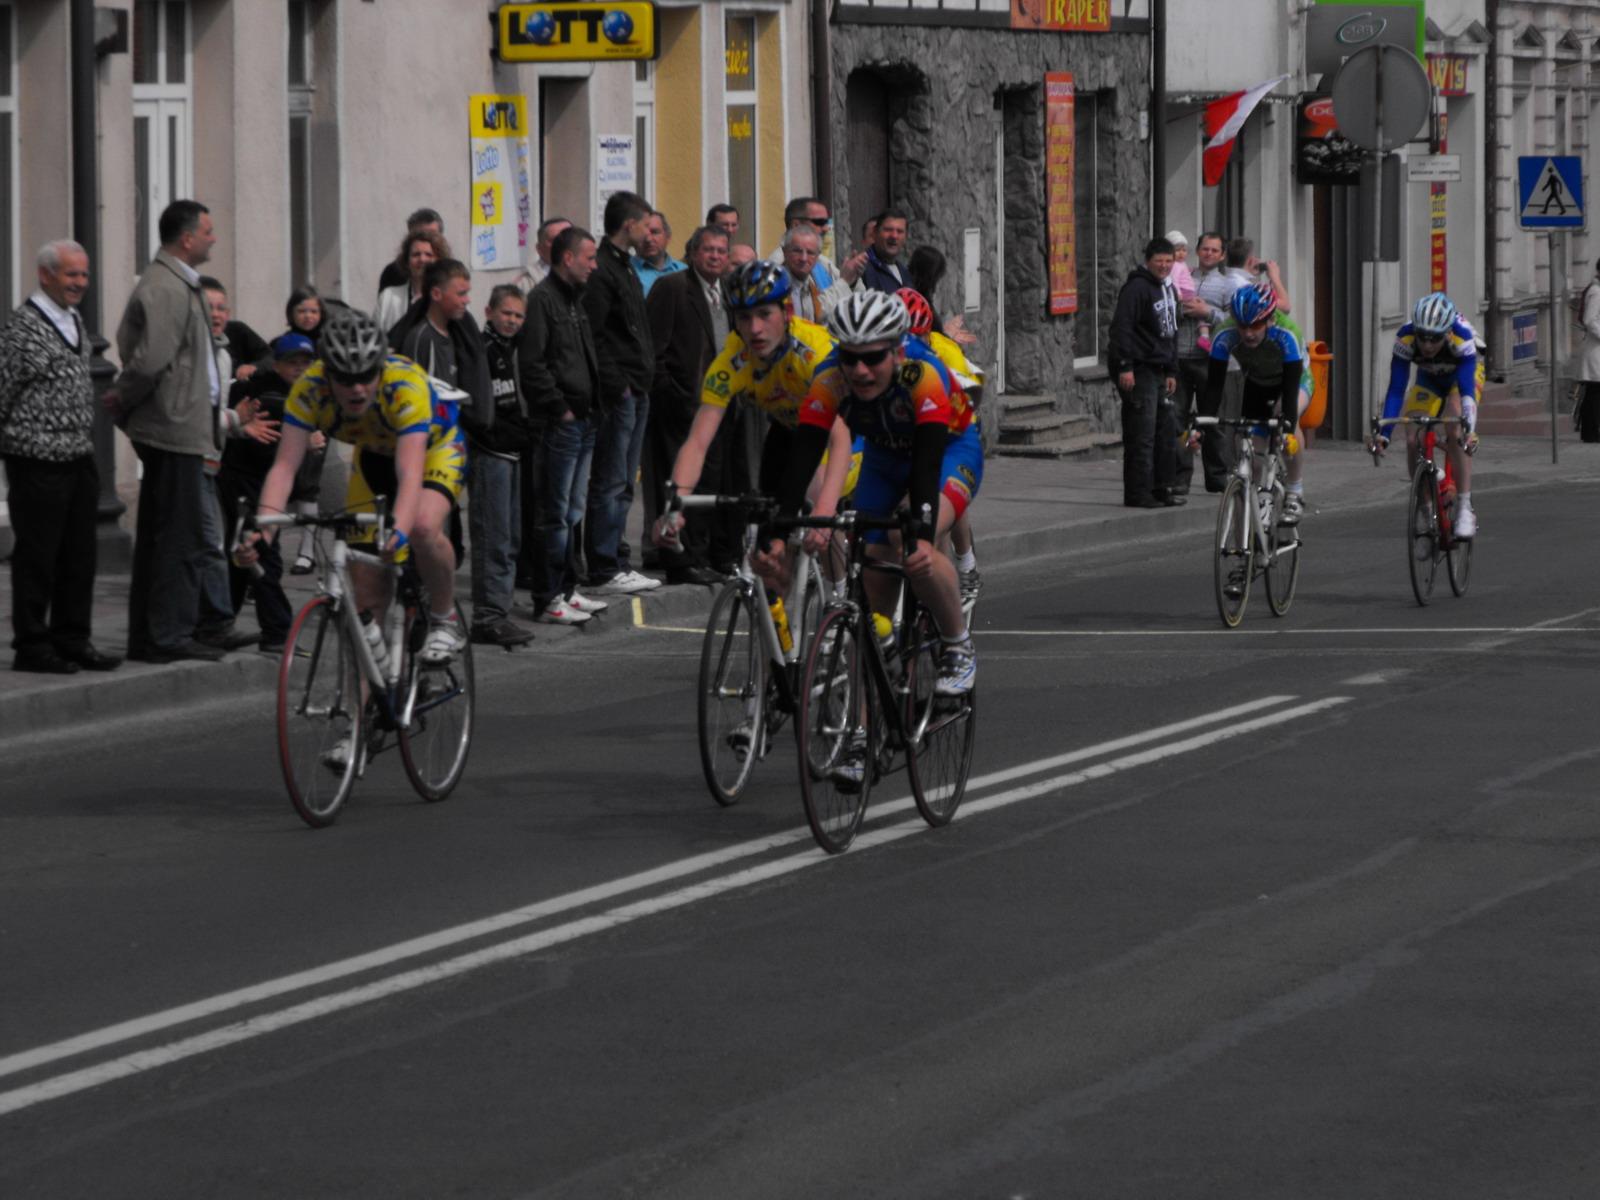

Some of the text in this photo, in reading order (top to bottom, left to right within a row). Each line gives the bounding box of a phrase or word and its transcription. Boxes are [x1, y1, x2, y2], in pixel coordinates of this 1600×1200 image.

[508, 9, 634, 46] LOTTO
[1425, 57, 1465, 91] WIS
[482, 101, 519, 131] LOTTO
